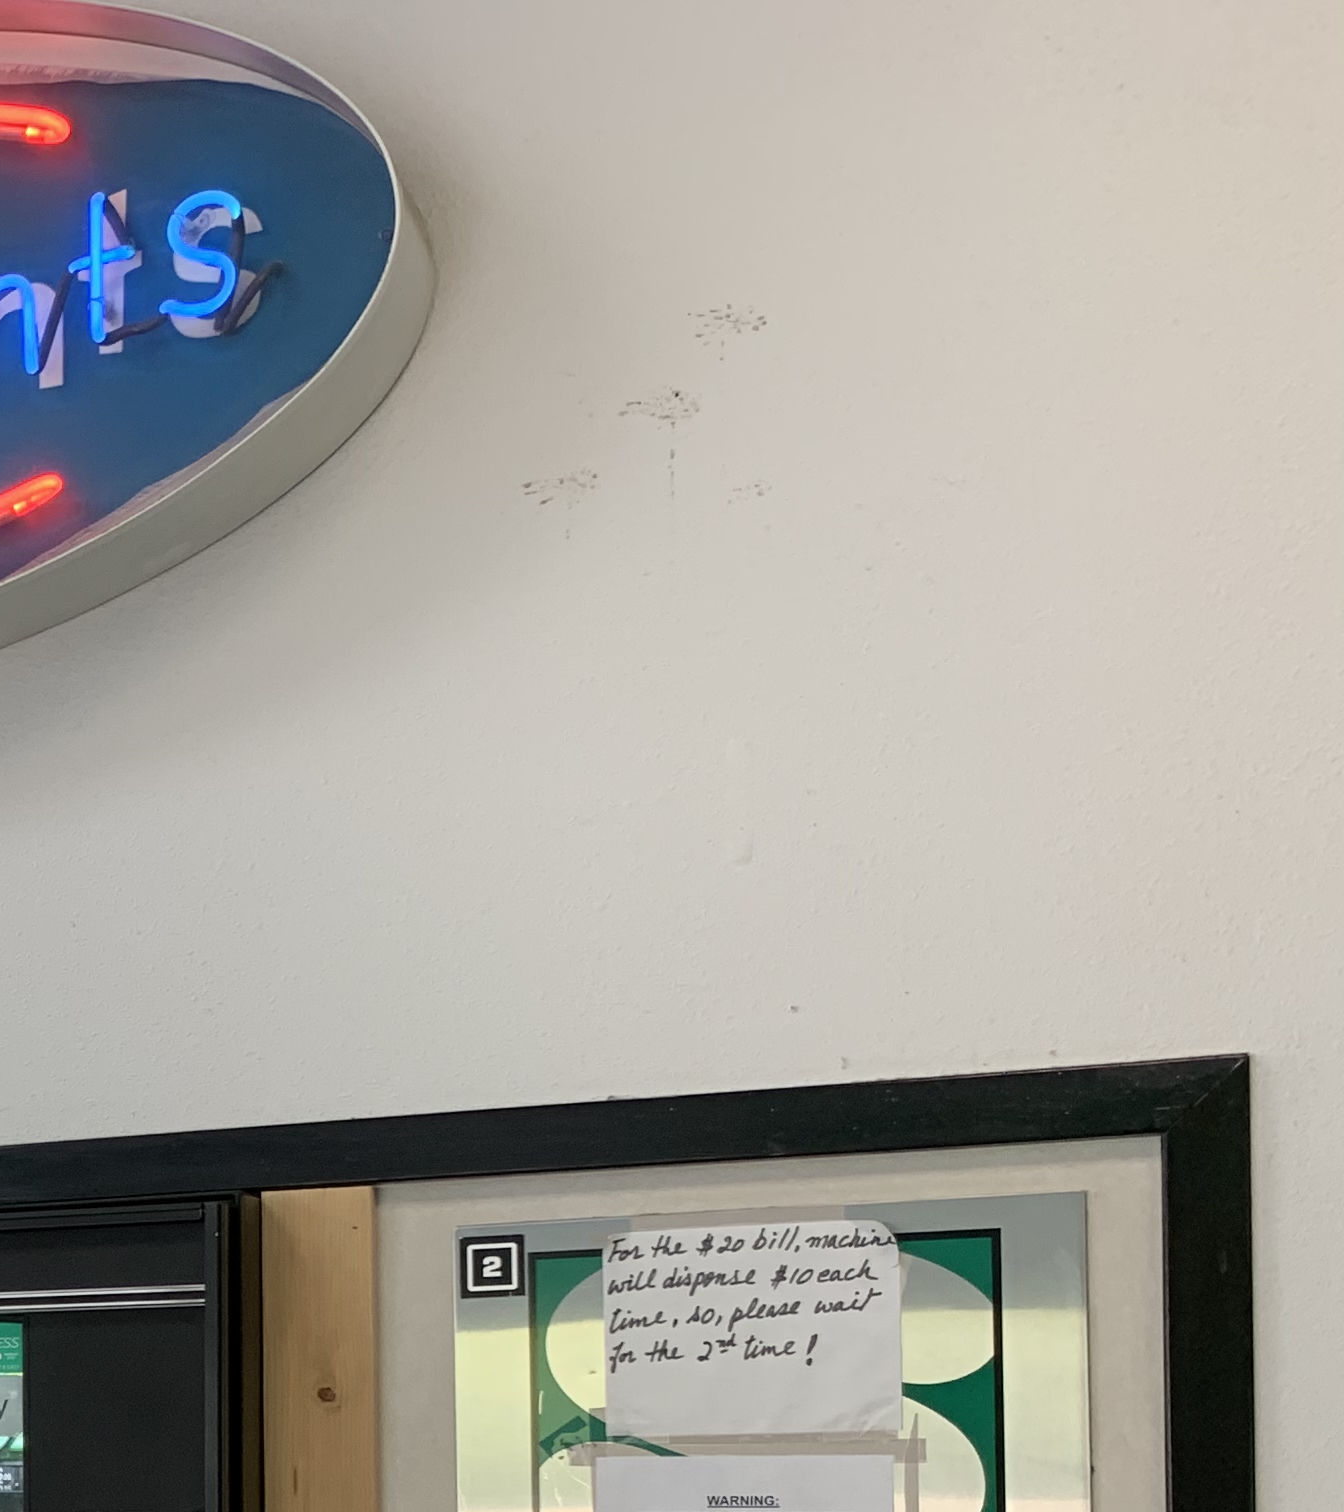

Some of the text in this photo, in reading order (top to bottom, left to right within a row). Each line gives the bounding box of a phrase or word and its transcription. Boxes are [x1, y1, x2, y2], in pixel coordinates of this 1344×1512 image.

[608, 1238, 644, 1262] For
[652, 1236, 687, 1258] the
[752, 1226, 800, 1252] bill,
[805, 1230, 896, 1250] machine
[482, 1257, 502, 1277] 2
[608, 1268, 656, 1294] will
[771, 1264, 814, 1290] $10
[816, 1260, 878, 1282] each
[686, 1306, 722, 1326] so,
[728, 1298, 800, 1332] please
[814, 1292, 882, 1314] wait
[610, 1351, 636, 1373] for
[644, 1348, 684, 1362] the
[707, 1496, 780, 1508] WARNING:
